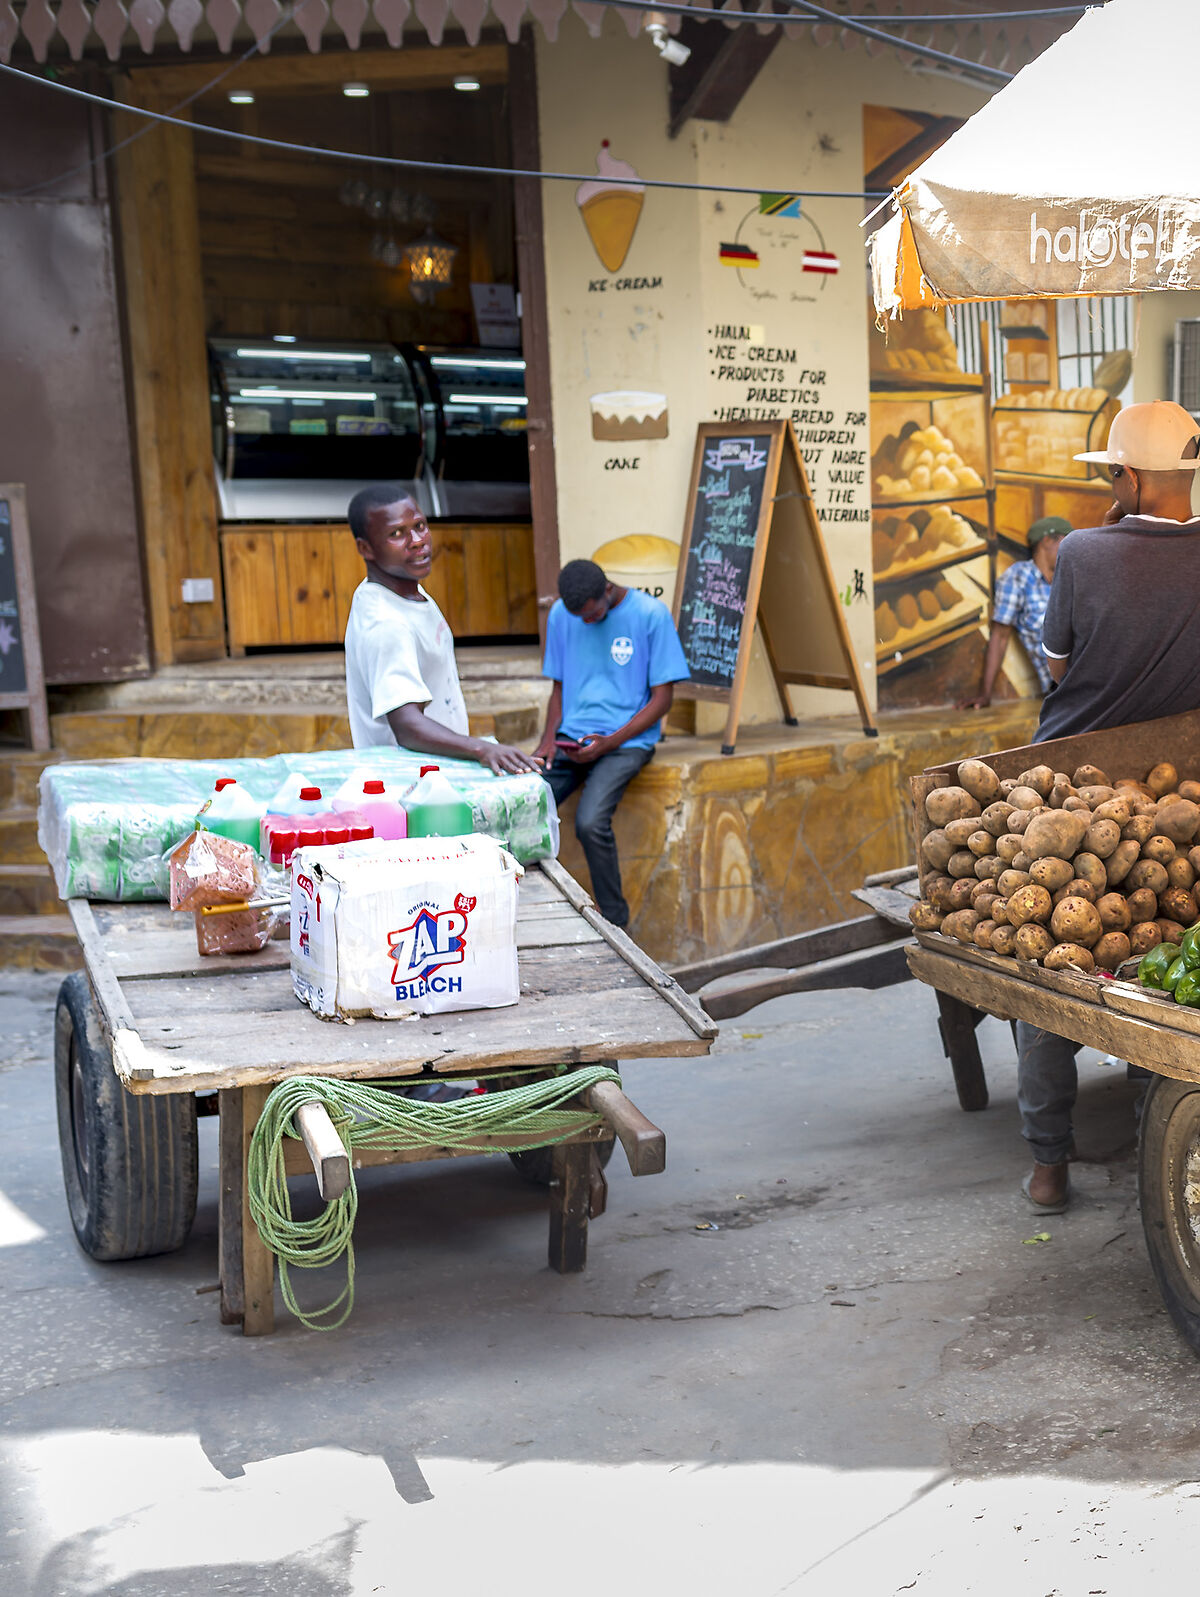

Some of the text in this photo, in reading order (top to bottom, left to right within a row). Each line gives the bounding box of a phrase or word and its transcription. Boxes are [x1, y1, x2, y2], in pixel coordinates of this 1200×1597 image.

[1030, 206, 1164, 269] halotel
[715, 325, 751, 340] HALAL
[718, 366, 826, 385] PRODUCTS FOR
[746, 388, 820, 404] DIABETICS
[791, 409, 834, 424] BREAD
[845, 412, 867, 426] FOR
[794, 429, 856, 444] HILDREN
[604, 457, 640, 470] CAKE
[832, 450, 867, 464] MORE
[828, 469, 865, 484] VALUE
[827, 489, 855, 503] THE
[389, 912, 466, 984] ZAP
[395, 976, 462, 1001] BLEACH
